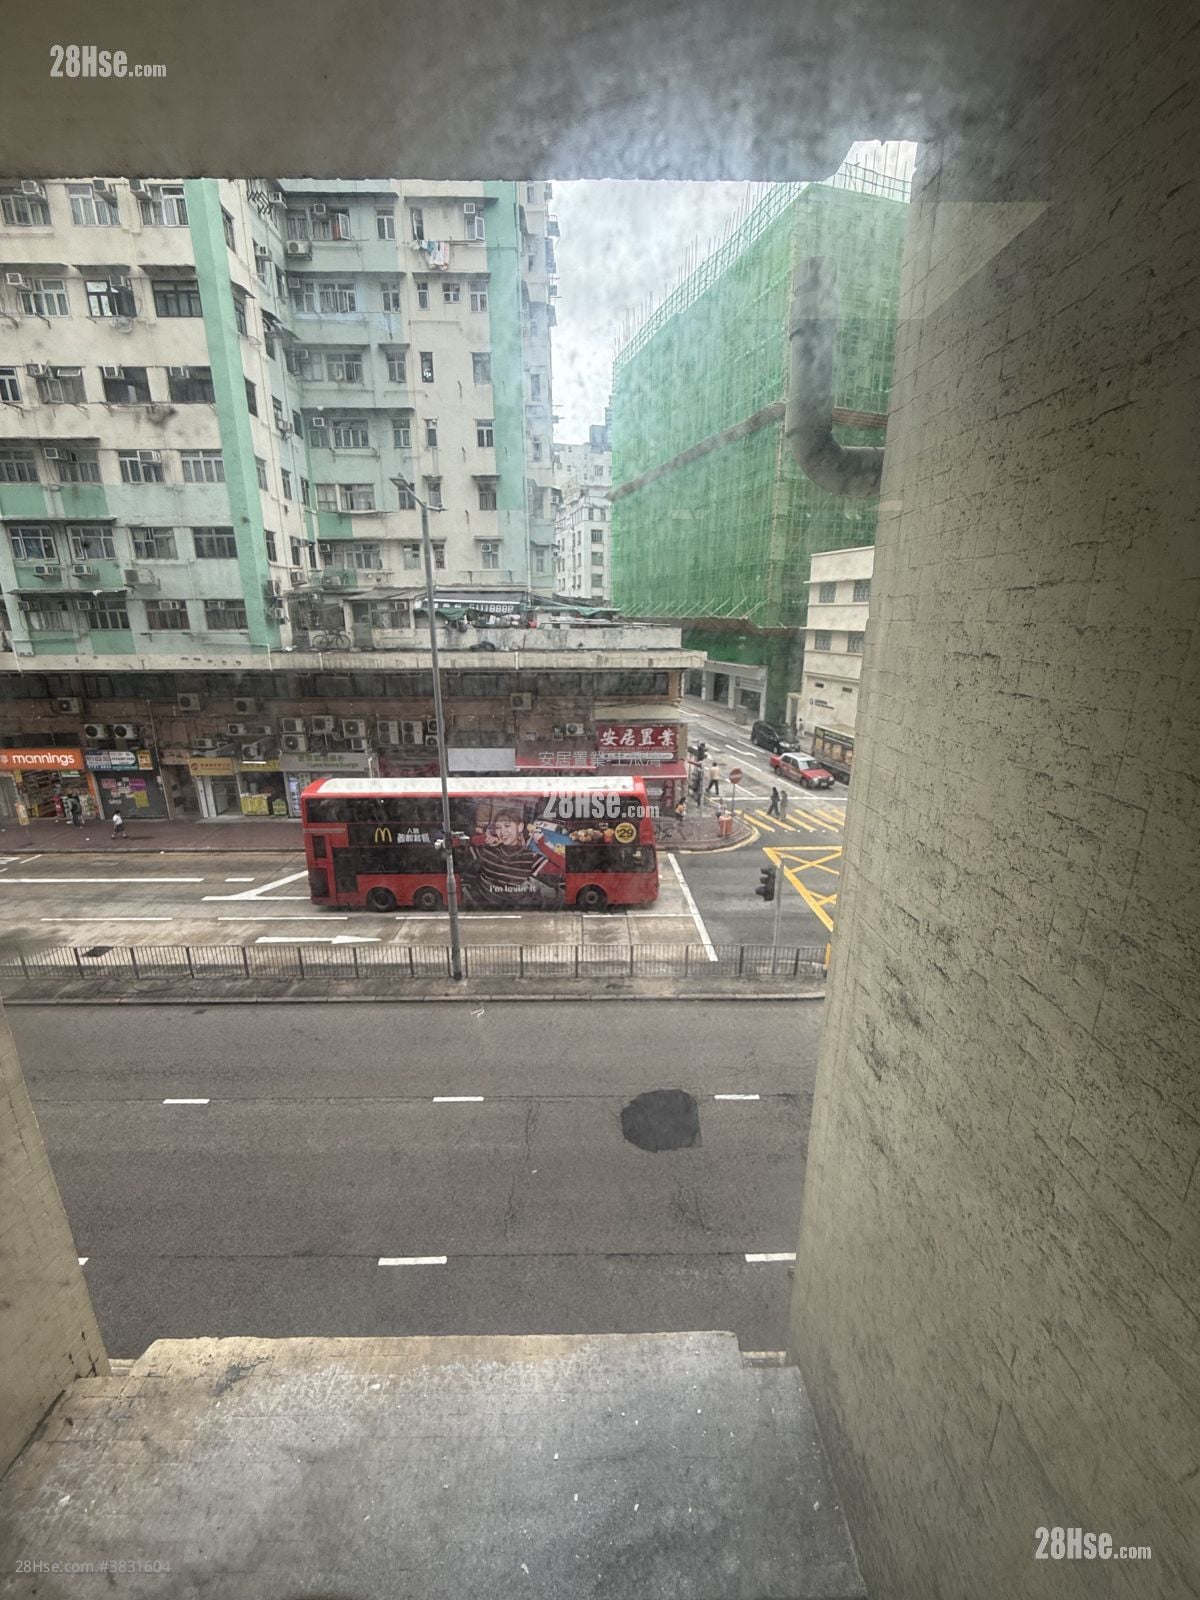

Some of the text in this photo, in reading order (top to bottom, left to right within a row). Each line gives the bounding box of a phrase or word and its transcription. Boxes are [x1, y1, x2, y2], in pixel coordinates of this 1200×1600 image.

[600, 727, 675, 746] 安居置業
[12, 752, 75, 766] mannings
